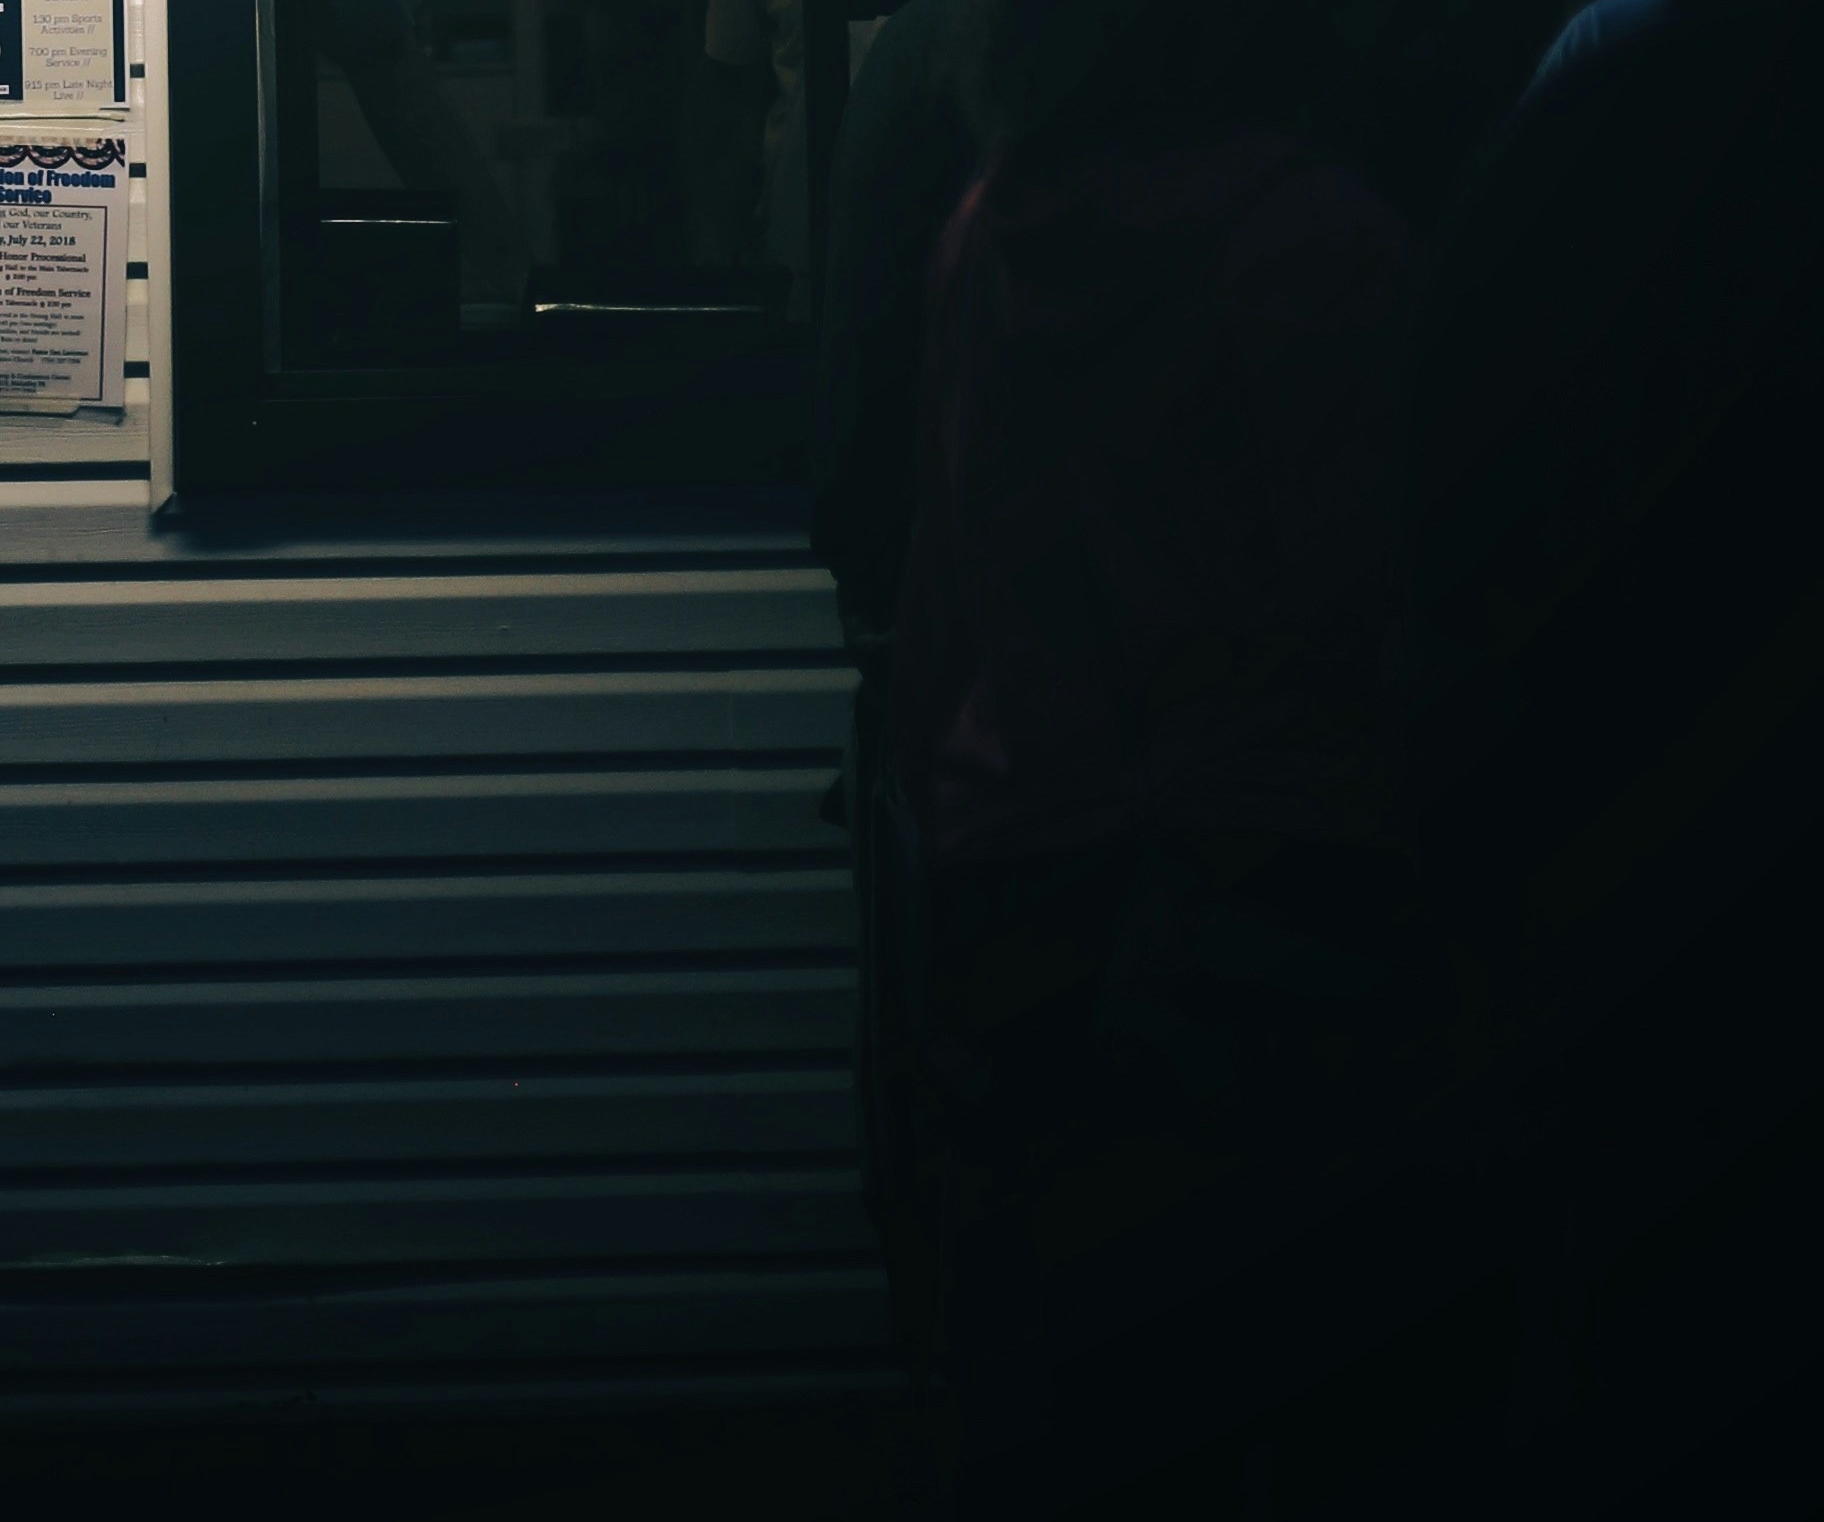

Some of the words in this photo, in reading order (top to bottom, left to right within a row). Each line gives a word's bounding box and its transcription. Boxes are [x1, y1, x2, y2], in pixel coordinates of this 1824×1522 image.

[54, 16, 69, 25] pm
[72, 14, 102, 25] Sports
[40, 25, 85, 34] Activities
[51, 49, 66, 57] pm
[69, 47, 107, 57] Evening
[46, 58, 80, 67] Service
[45, 83, 60, 91] pm
[63, 80, 84, 89] Late
[87, 80, 113, 91] Night
[54, 91, 74, 100] Live
[28, 170, 43, 186] of
[47, 170, 115, 188] Freedom
[33, 210, 48, 218] our
[53, 210, 92, 221] Country,
[23, 221, 62, 230] Veterans
[7, 235, 28, 247] July
[49, 236, 76, 246] 2018
[31, 253, 86, 262] Processional
[5, 287, 16, 296] of
[16, 288, 56, 297] Freedom
[58, 289, 91, 298] Service
